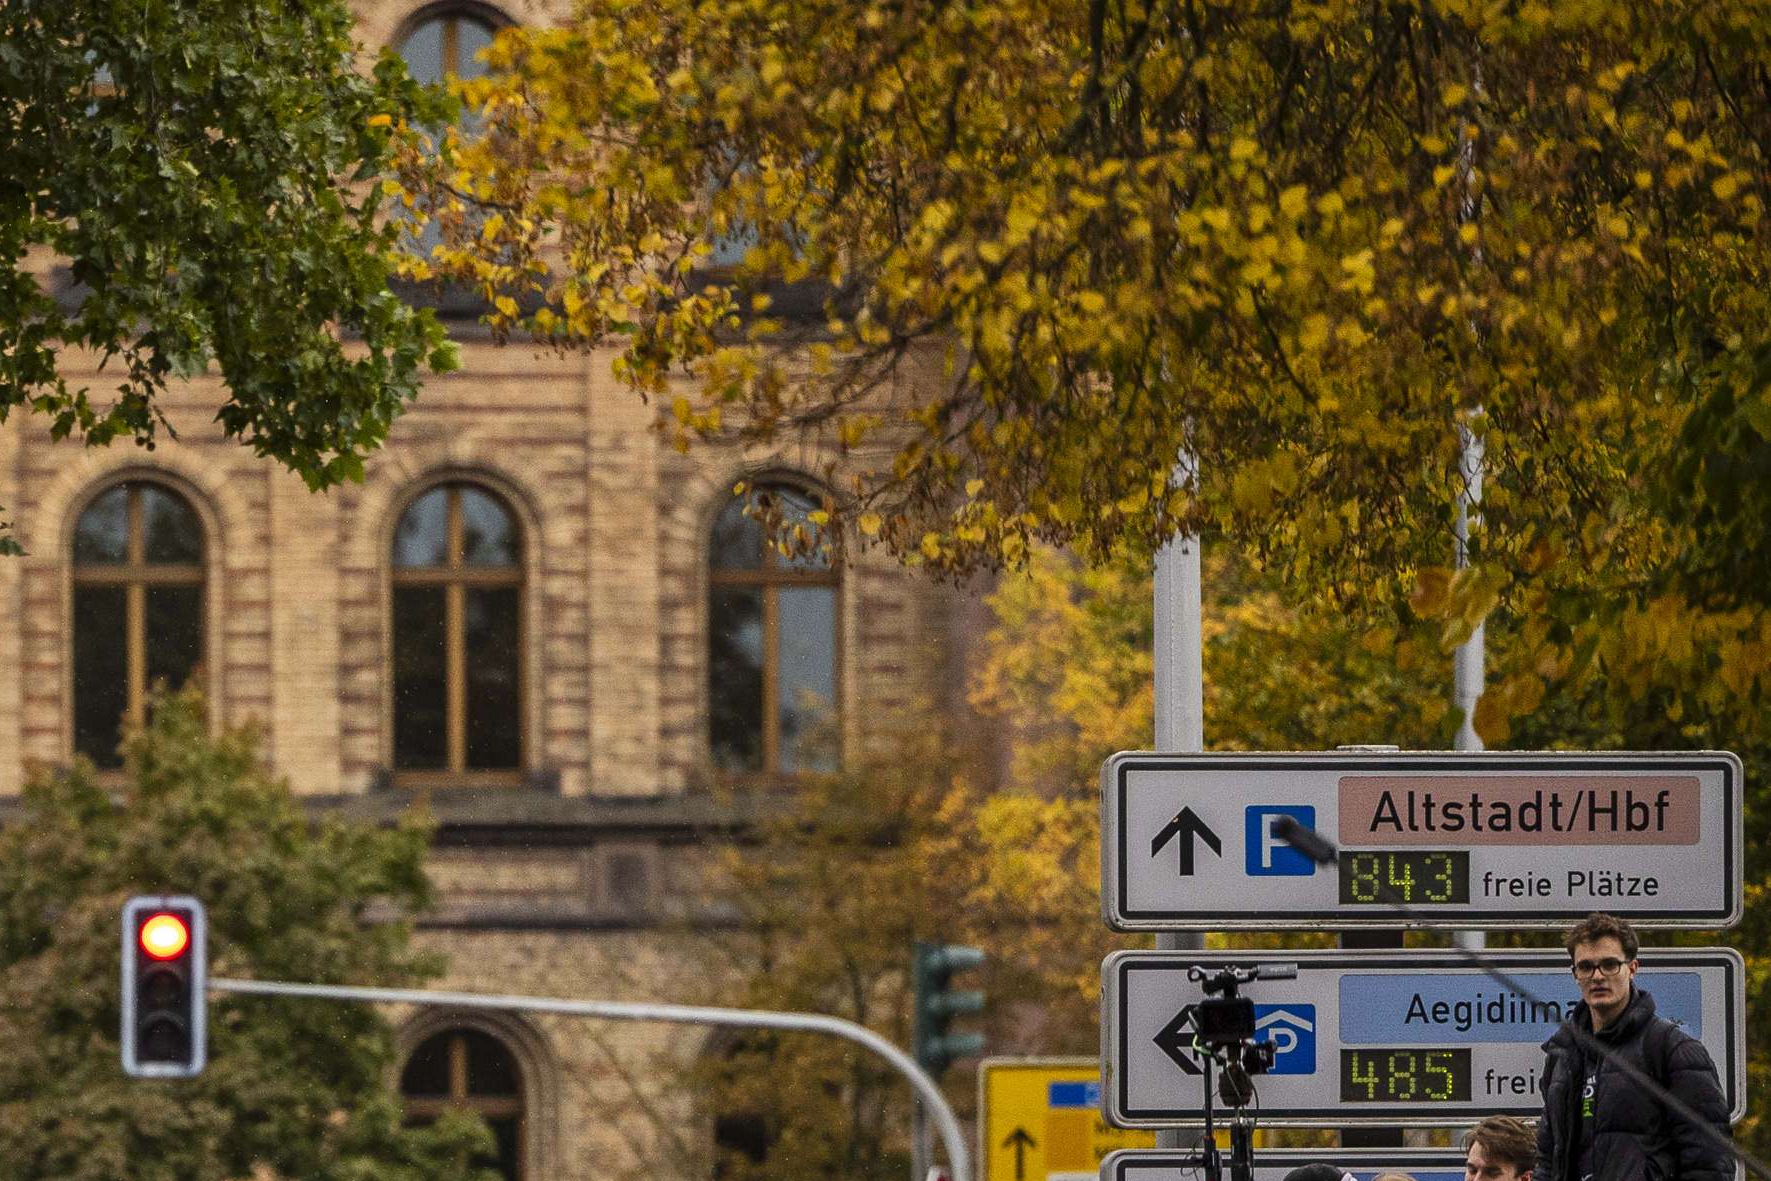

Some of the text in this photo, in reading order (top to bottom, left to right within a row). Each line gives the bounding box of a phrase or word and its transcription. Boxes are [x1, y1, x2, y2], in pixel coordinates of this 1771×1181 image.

[1369, 789, 1670, 833] Altstadt/Hbf
[1352, 853, 1452, 901] 843
[1483, 870, 1660, 898] freie Plätze
[1352, 1051, 1453, 1099] 485
